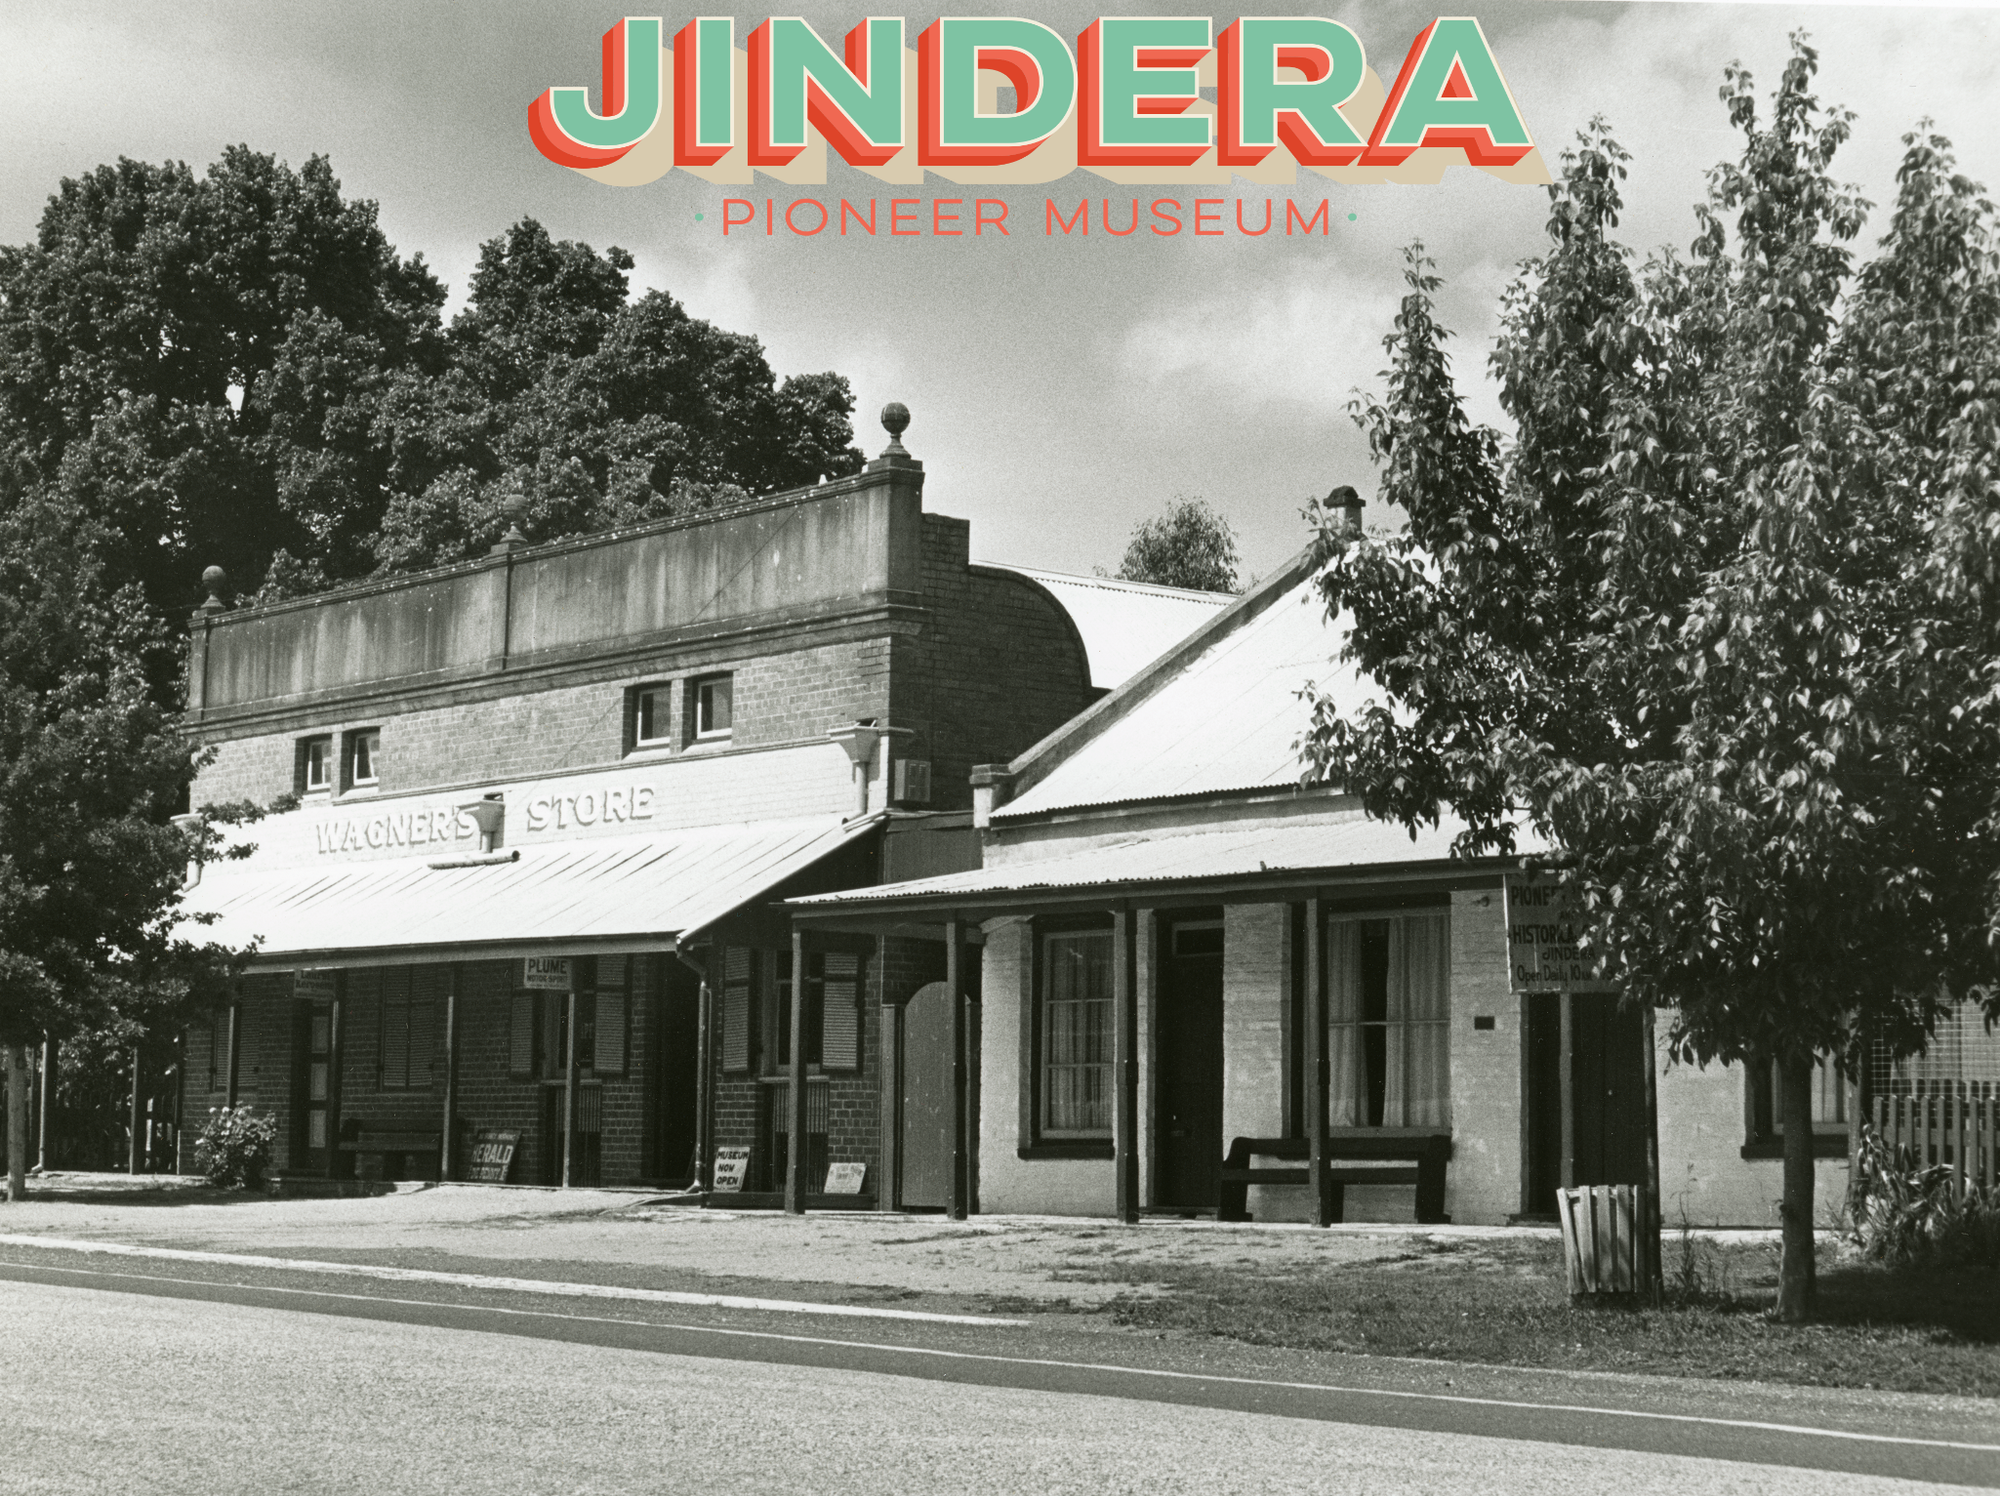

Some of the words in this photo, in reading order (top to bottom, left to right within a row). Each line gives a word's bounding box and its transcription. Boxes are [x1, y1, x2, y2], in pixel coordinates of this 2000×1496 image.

[316, 806, 480, 854] WAGNER'S
[526, 783, 656, 832] STORE
[1541, 946, 1597, 961] JINDERA
[528, 957, 568, 974] PLUME
[1516, 964, 1542, 987] Open
[1543, 964, 1568, 987] Daily
[471, 1143, 514, 1164] HERALD
[716, 1150, 749, 1161] MUSEUM
[717, 1163, 735, 1173] NOW
[715, 1175, 739, 1186] OPEN
